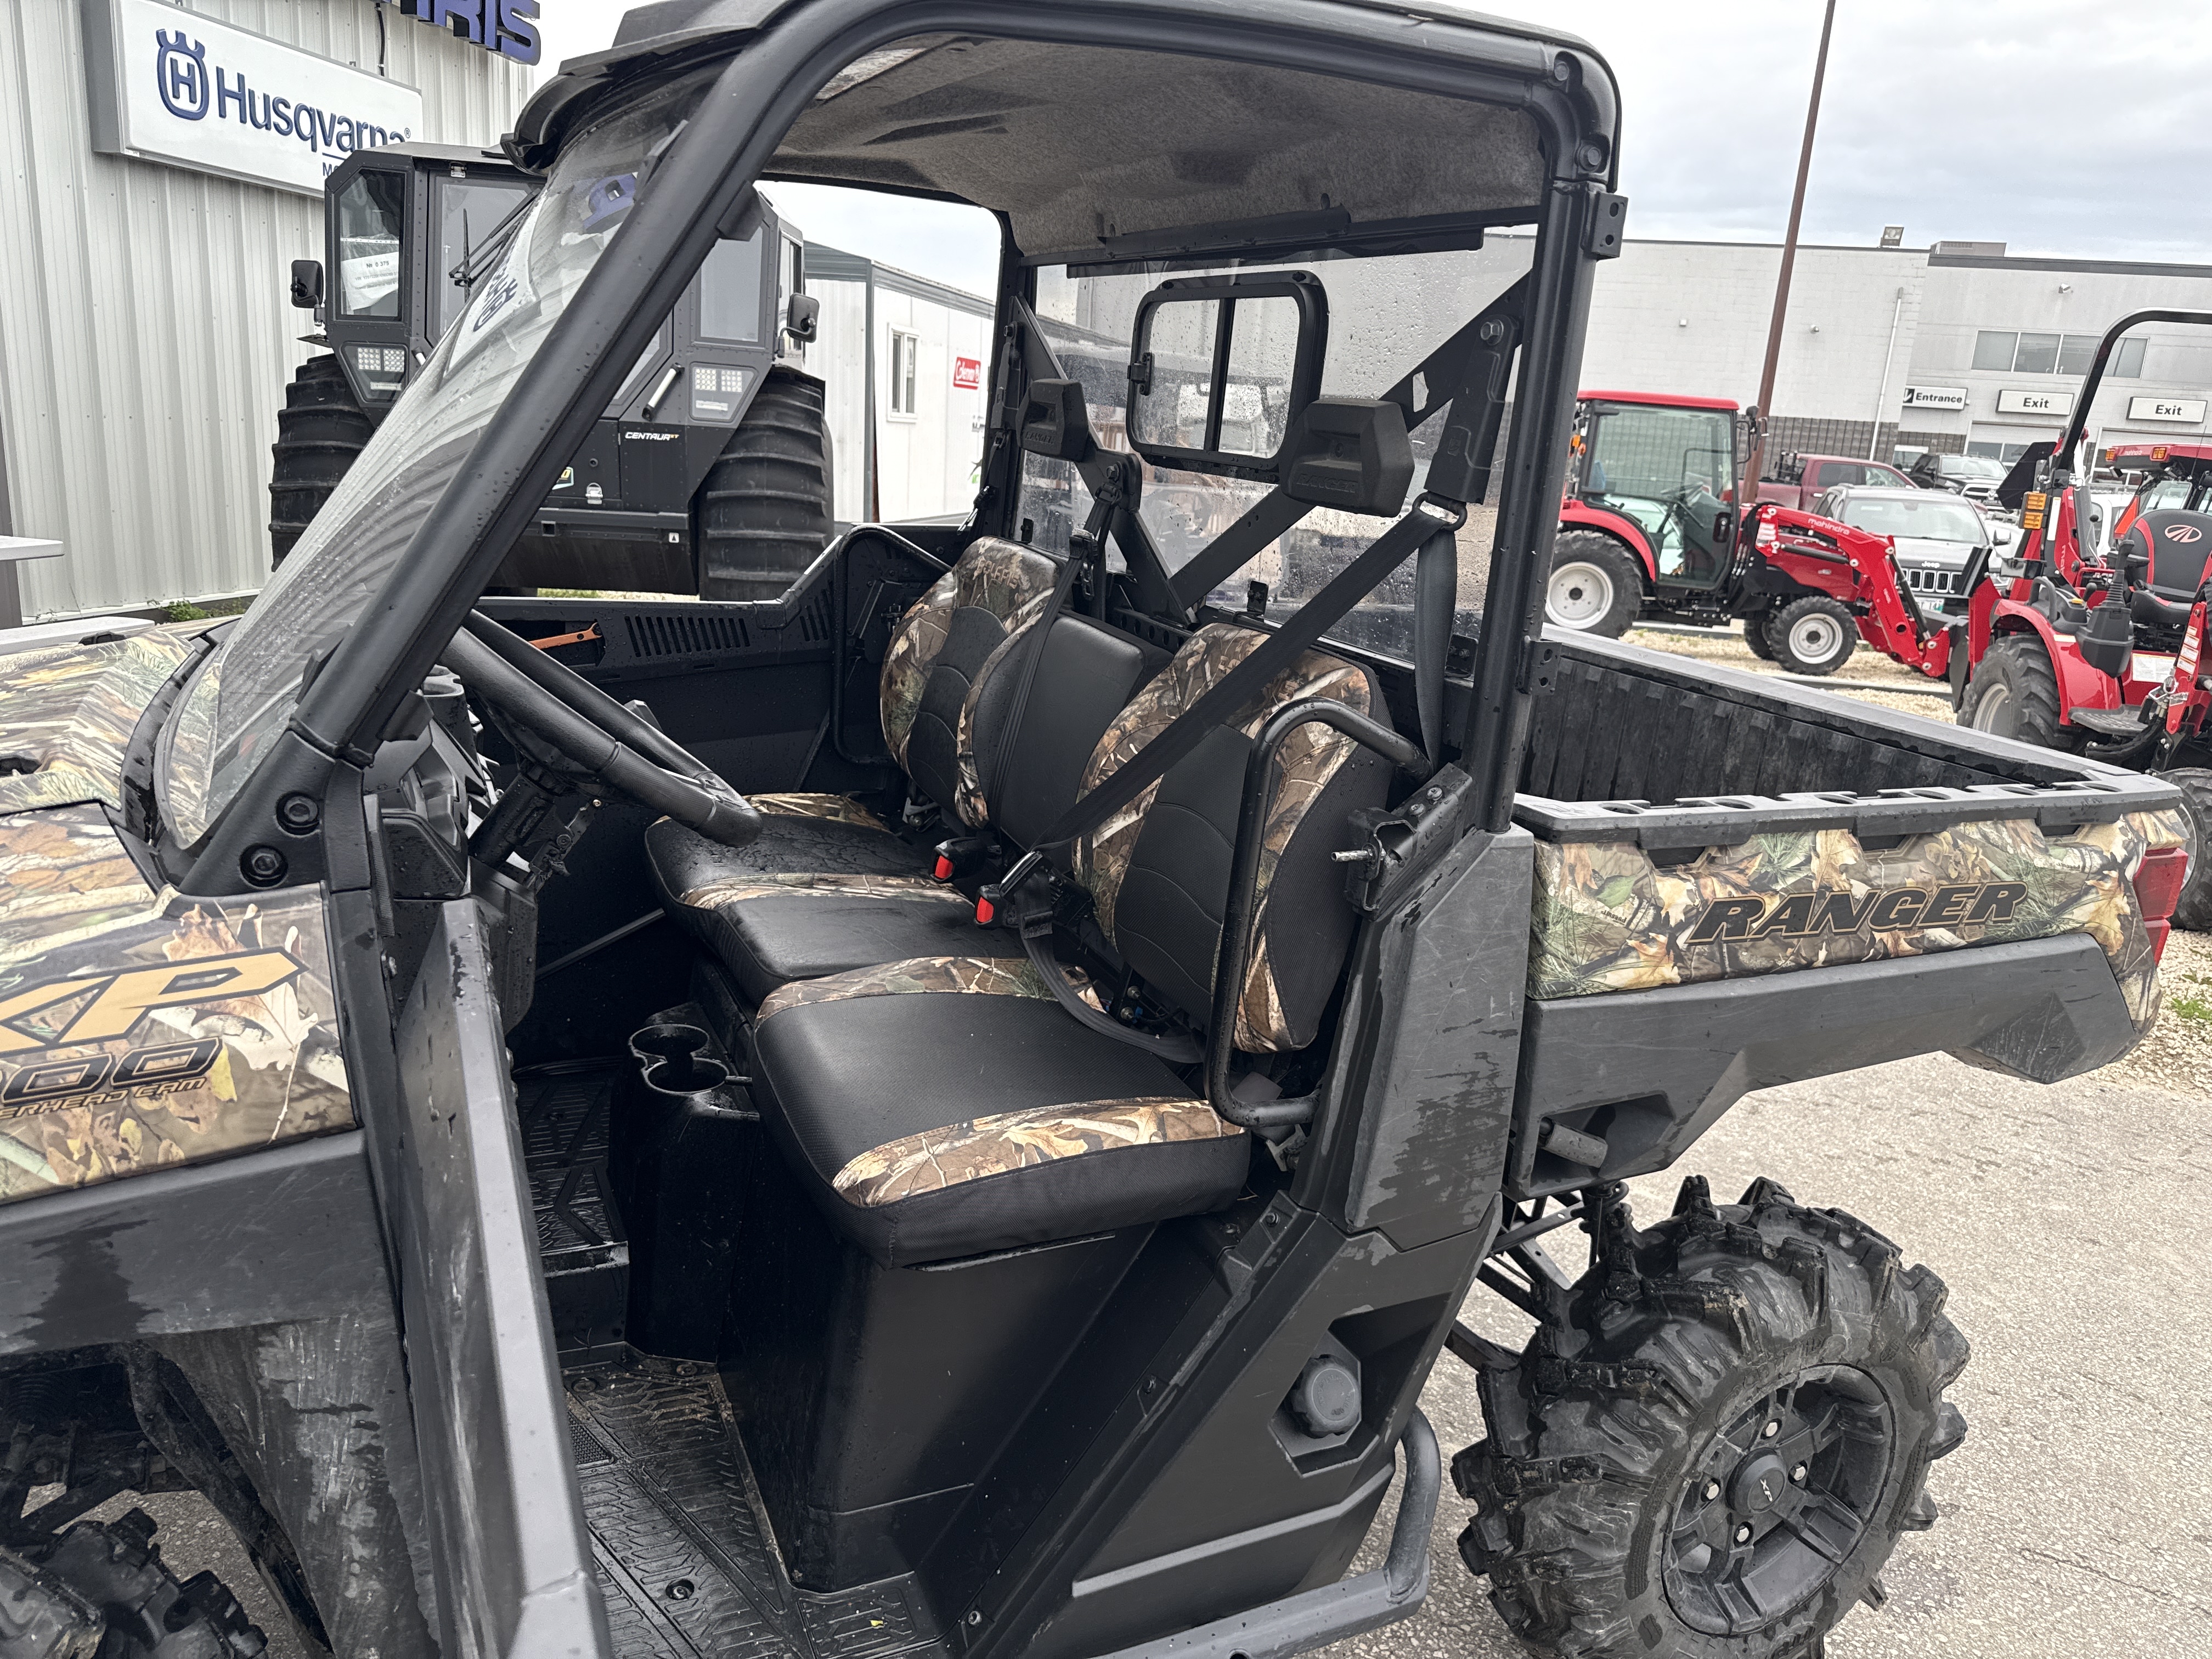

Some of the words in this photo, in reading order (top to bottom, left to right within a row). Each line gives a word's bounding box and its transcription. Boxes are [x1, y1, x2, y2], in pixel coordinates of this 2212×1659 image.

[1915, 392, 1963, 404] Entrance
[2023, 397, 2050, 409] Exit
[2155, 404, 2182, 416] Exit
[624, 431, 671, 441] CENTAUR
[1808, 517, 1849, 536] mahindra
[1684, 881, 2028, 945] RANGER
[134, 1076, 207, 1098] CAM
[1759, 1479, 1773, 1502] XP
